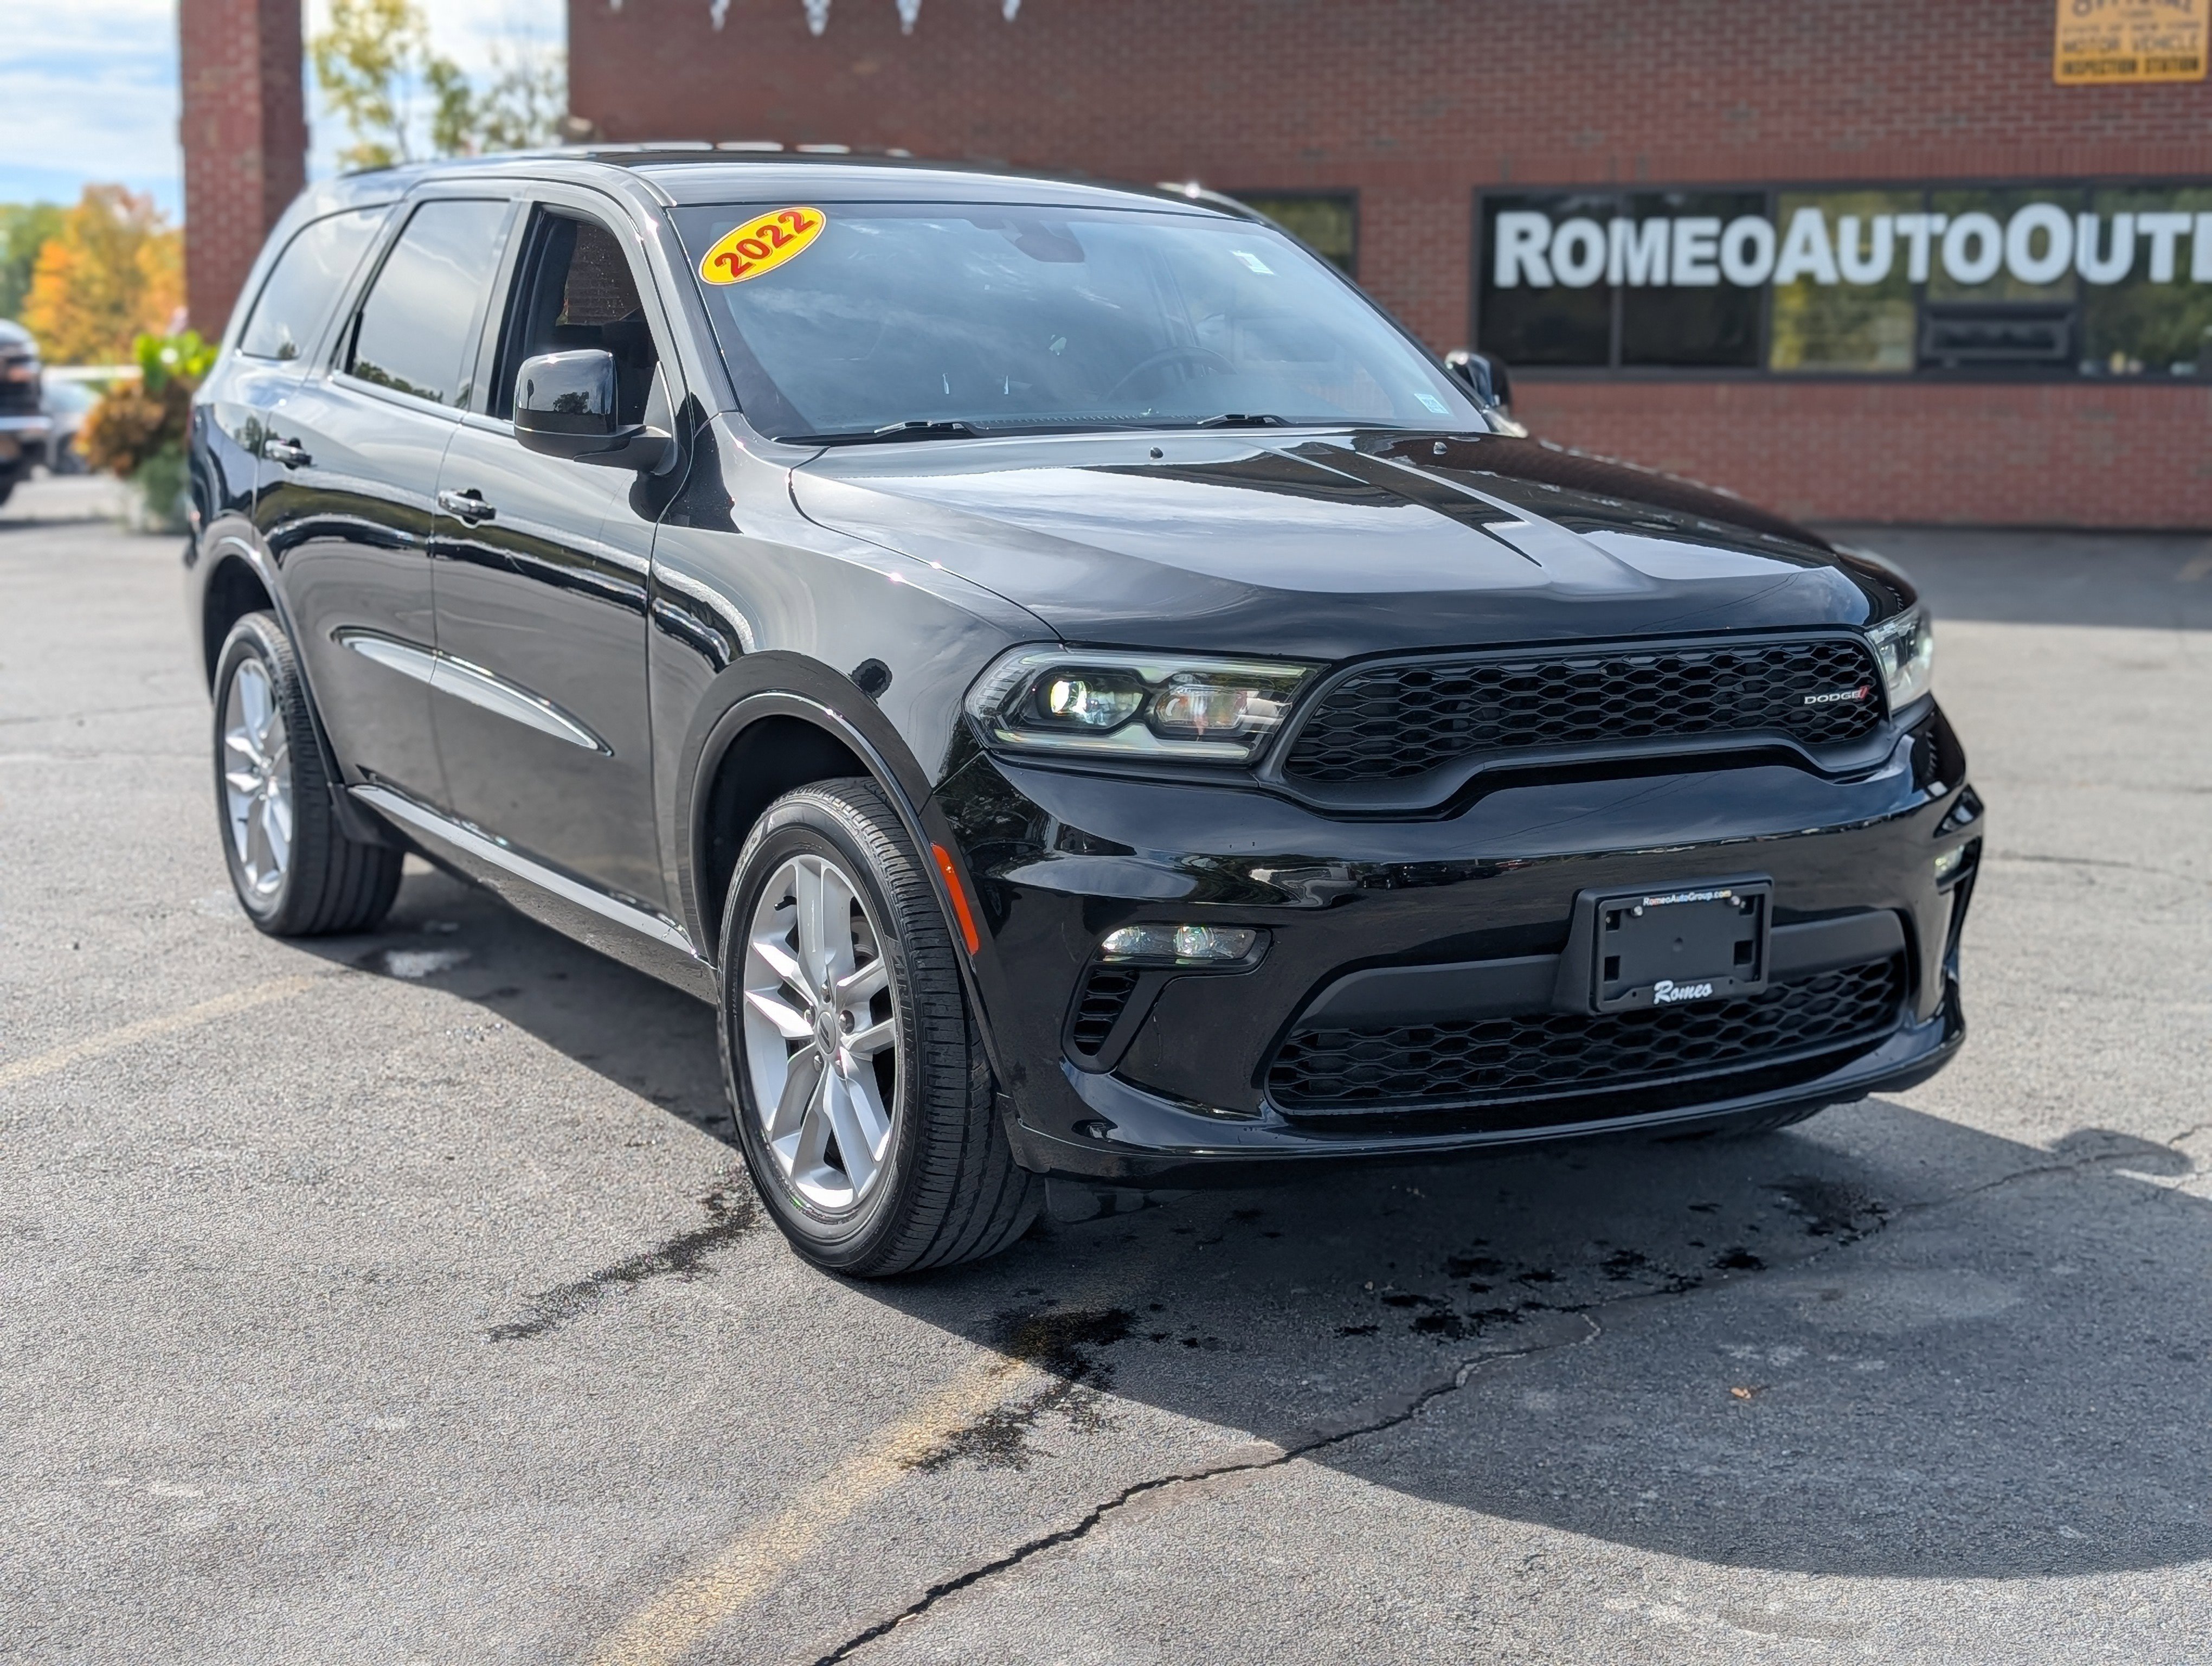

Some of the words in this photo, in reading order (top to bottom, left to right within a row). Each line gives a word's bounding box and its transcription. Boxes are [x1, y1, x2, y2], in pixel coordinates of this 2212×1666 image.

[714, 211, 818, 278] 2022
[1804, 690, 1861, 704] DODGE
[1643, 889, 1732, 906] RomeoAutoGroup.com
[1652, 979, 1714, 1005] Romeo
